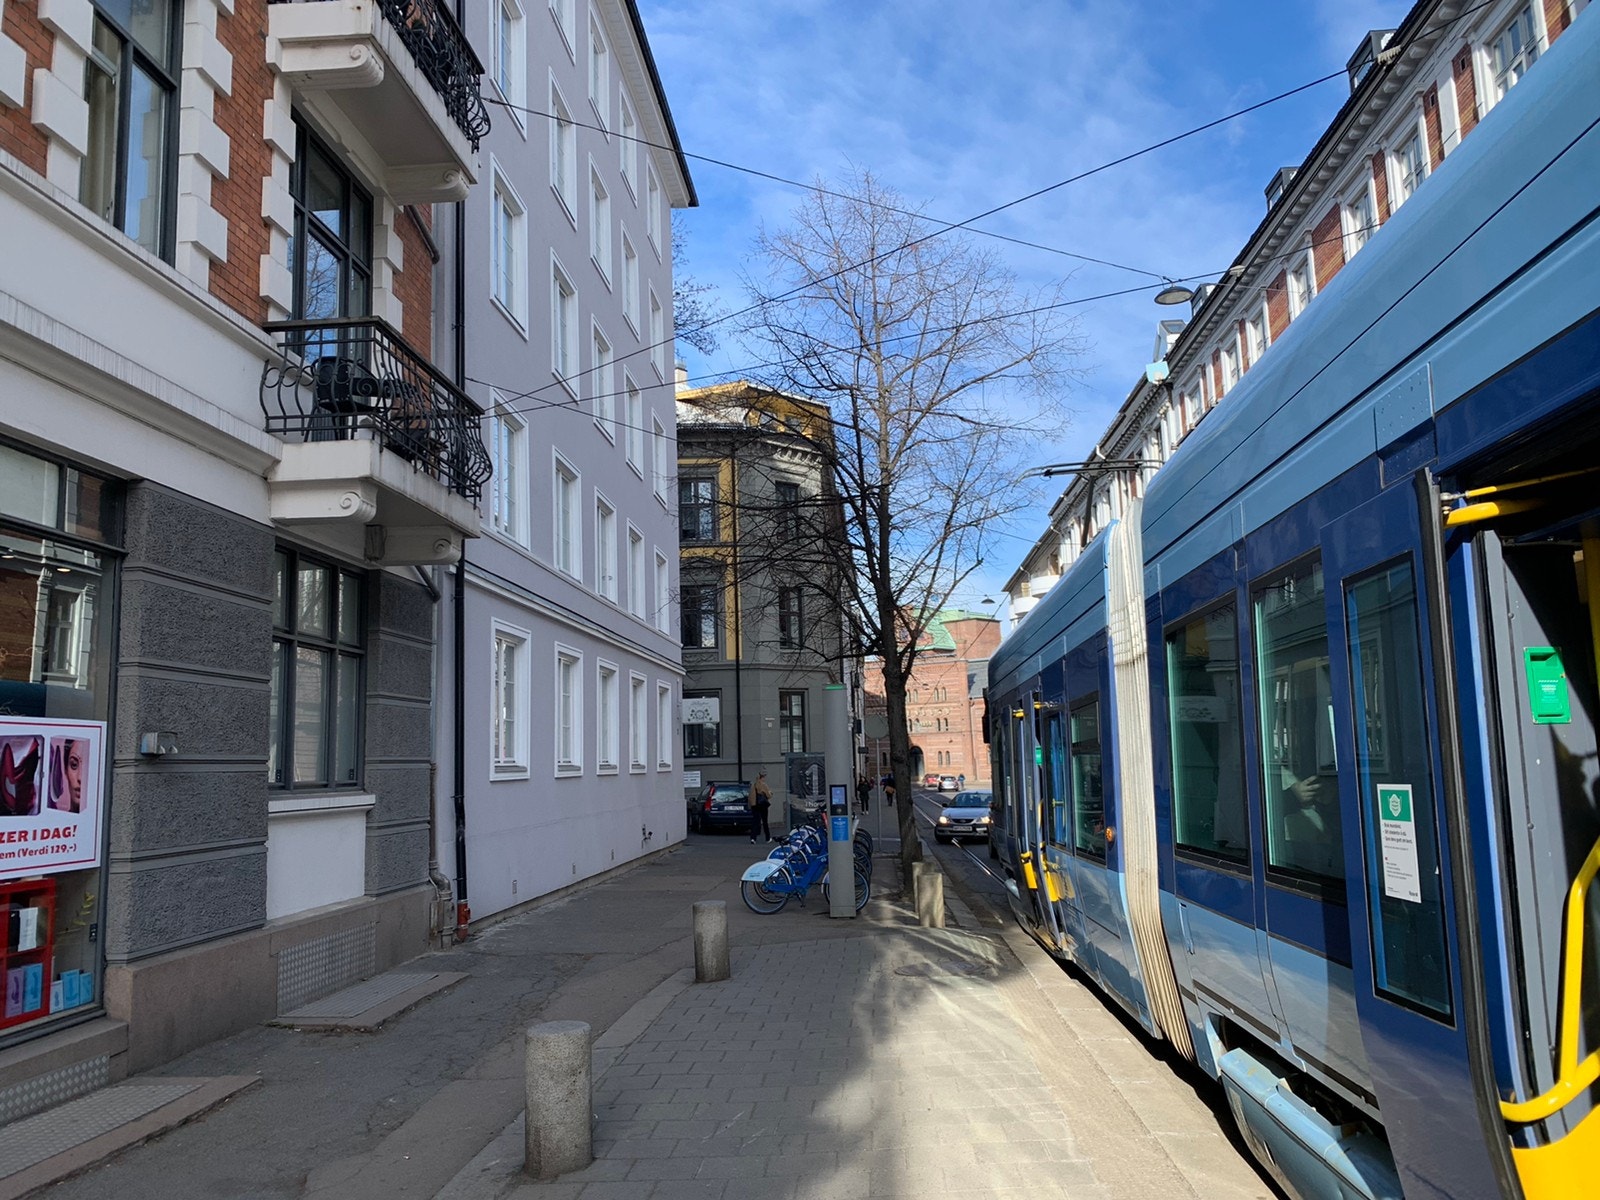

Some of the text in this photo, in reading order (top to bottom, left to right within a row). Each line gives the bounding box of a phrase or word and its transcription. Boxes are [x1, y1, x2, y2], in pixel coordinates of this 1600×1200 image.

[32, 829, 37, 841] I
[40, 824, 77, 840] DAG!
[17, 845, 49, 858] (Verdi
[51, 843, 77, 854] 129,-)
